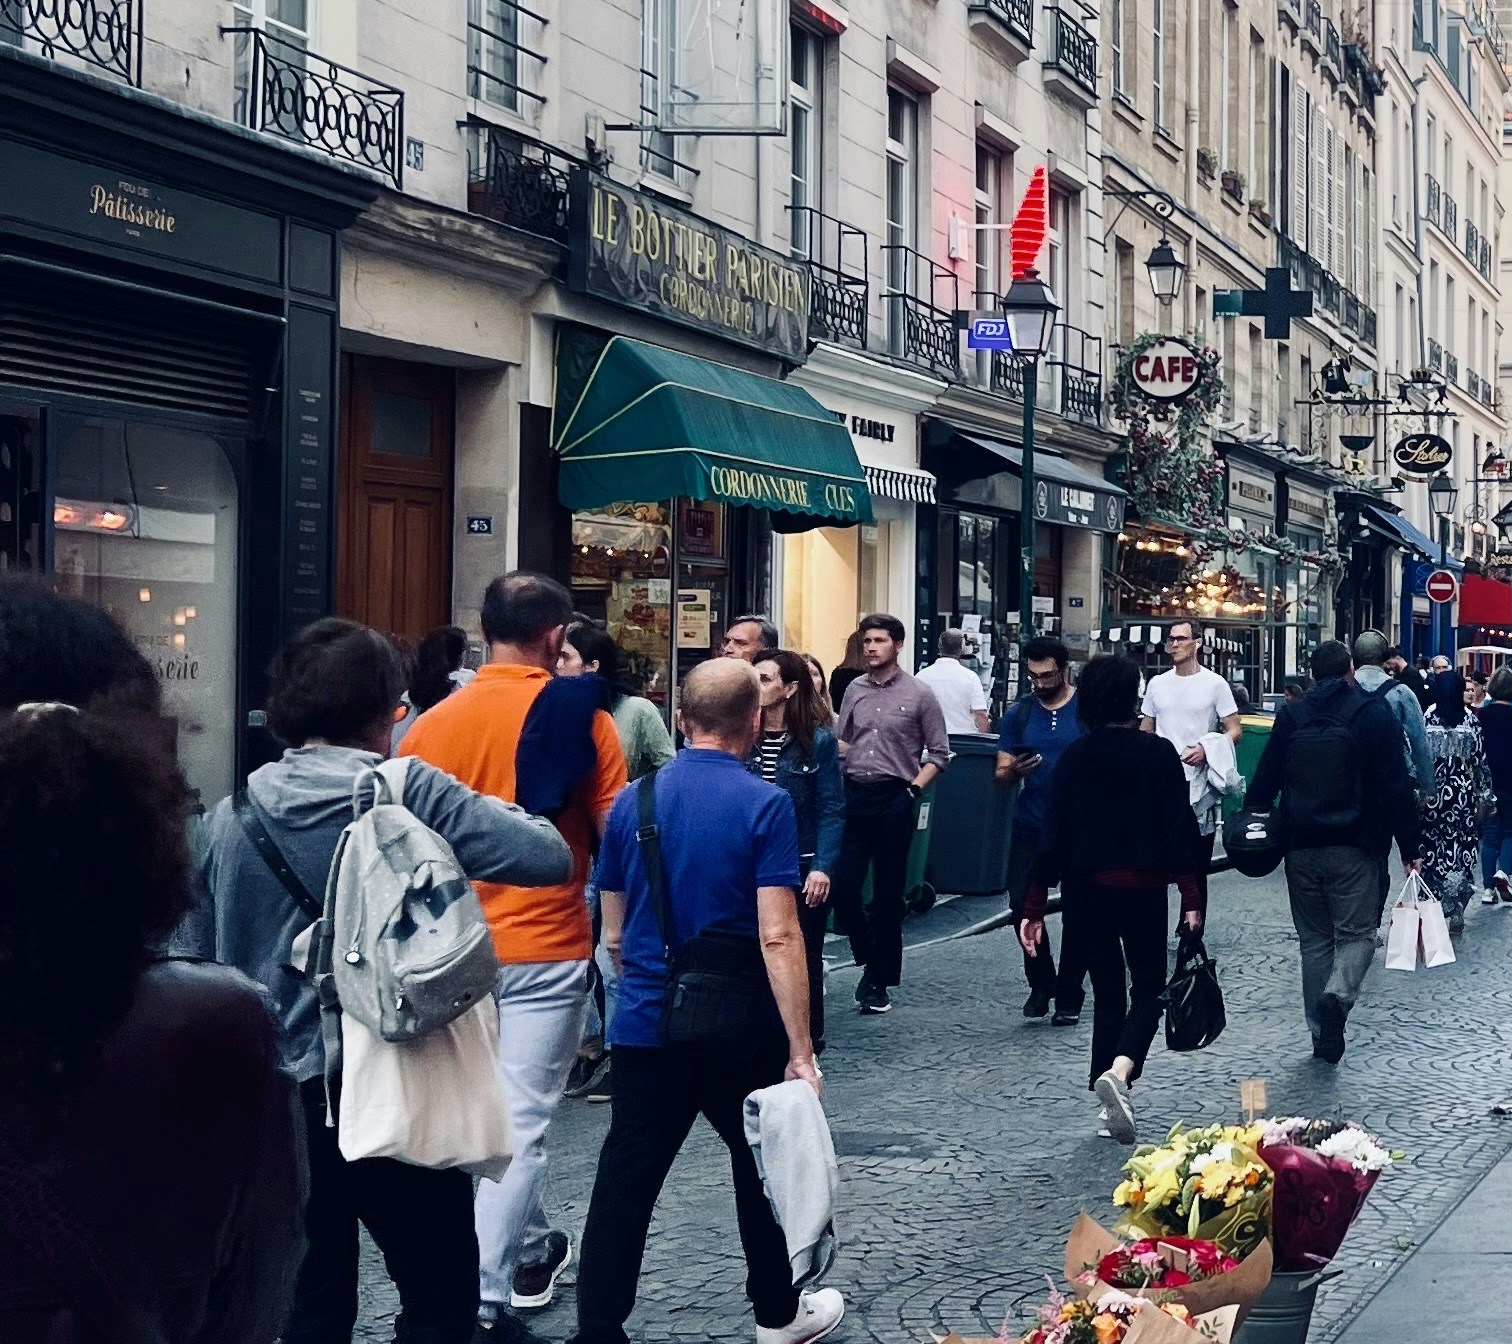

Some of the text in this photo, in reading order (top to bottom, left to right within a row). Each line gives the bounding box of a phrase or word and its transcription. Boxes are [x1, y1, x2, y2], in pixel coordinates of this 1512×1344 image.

[90, 185, 175, 233] Pâtisserie
[592, 188, 806, 316] LE BOTTIER PARISIEN
[659, 272, 752, 333] CORDONNERIE
[977, 323, 1005, 336] FDJ
[1135, 356, 1195, 383] CAFE
[711, 465, 855, 512] CORDONNERIE CLES
[470, 520, 488, 531] 45
